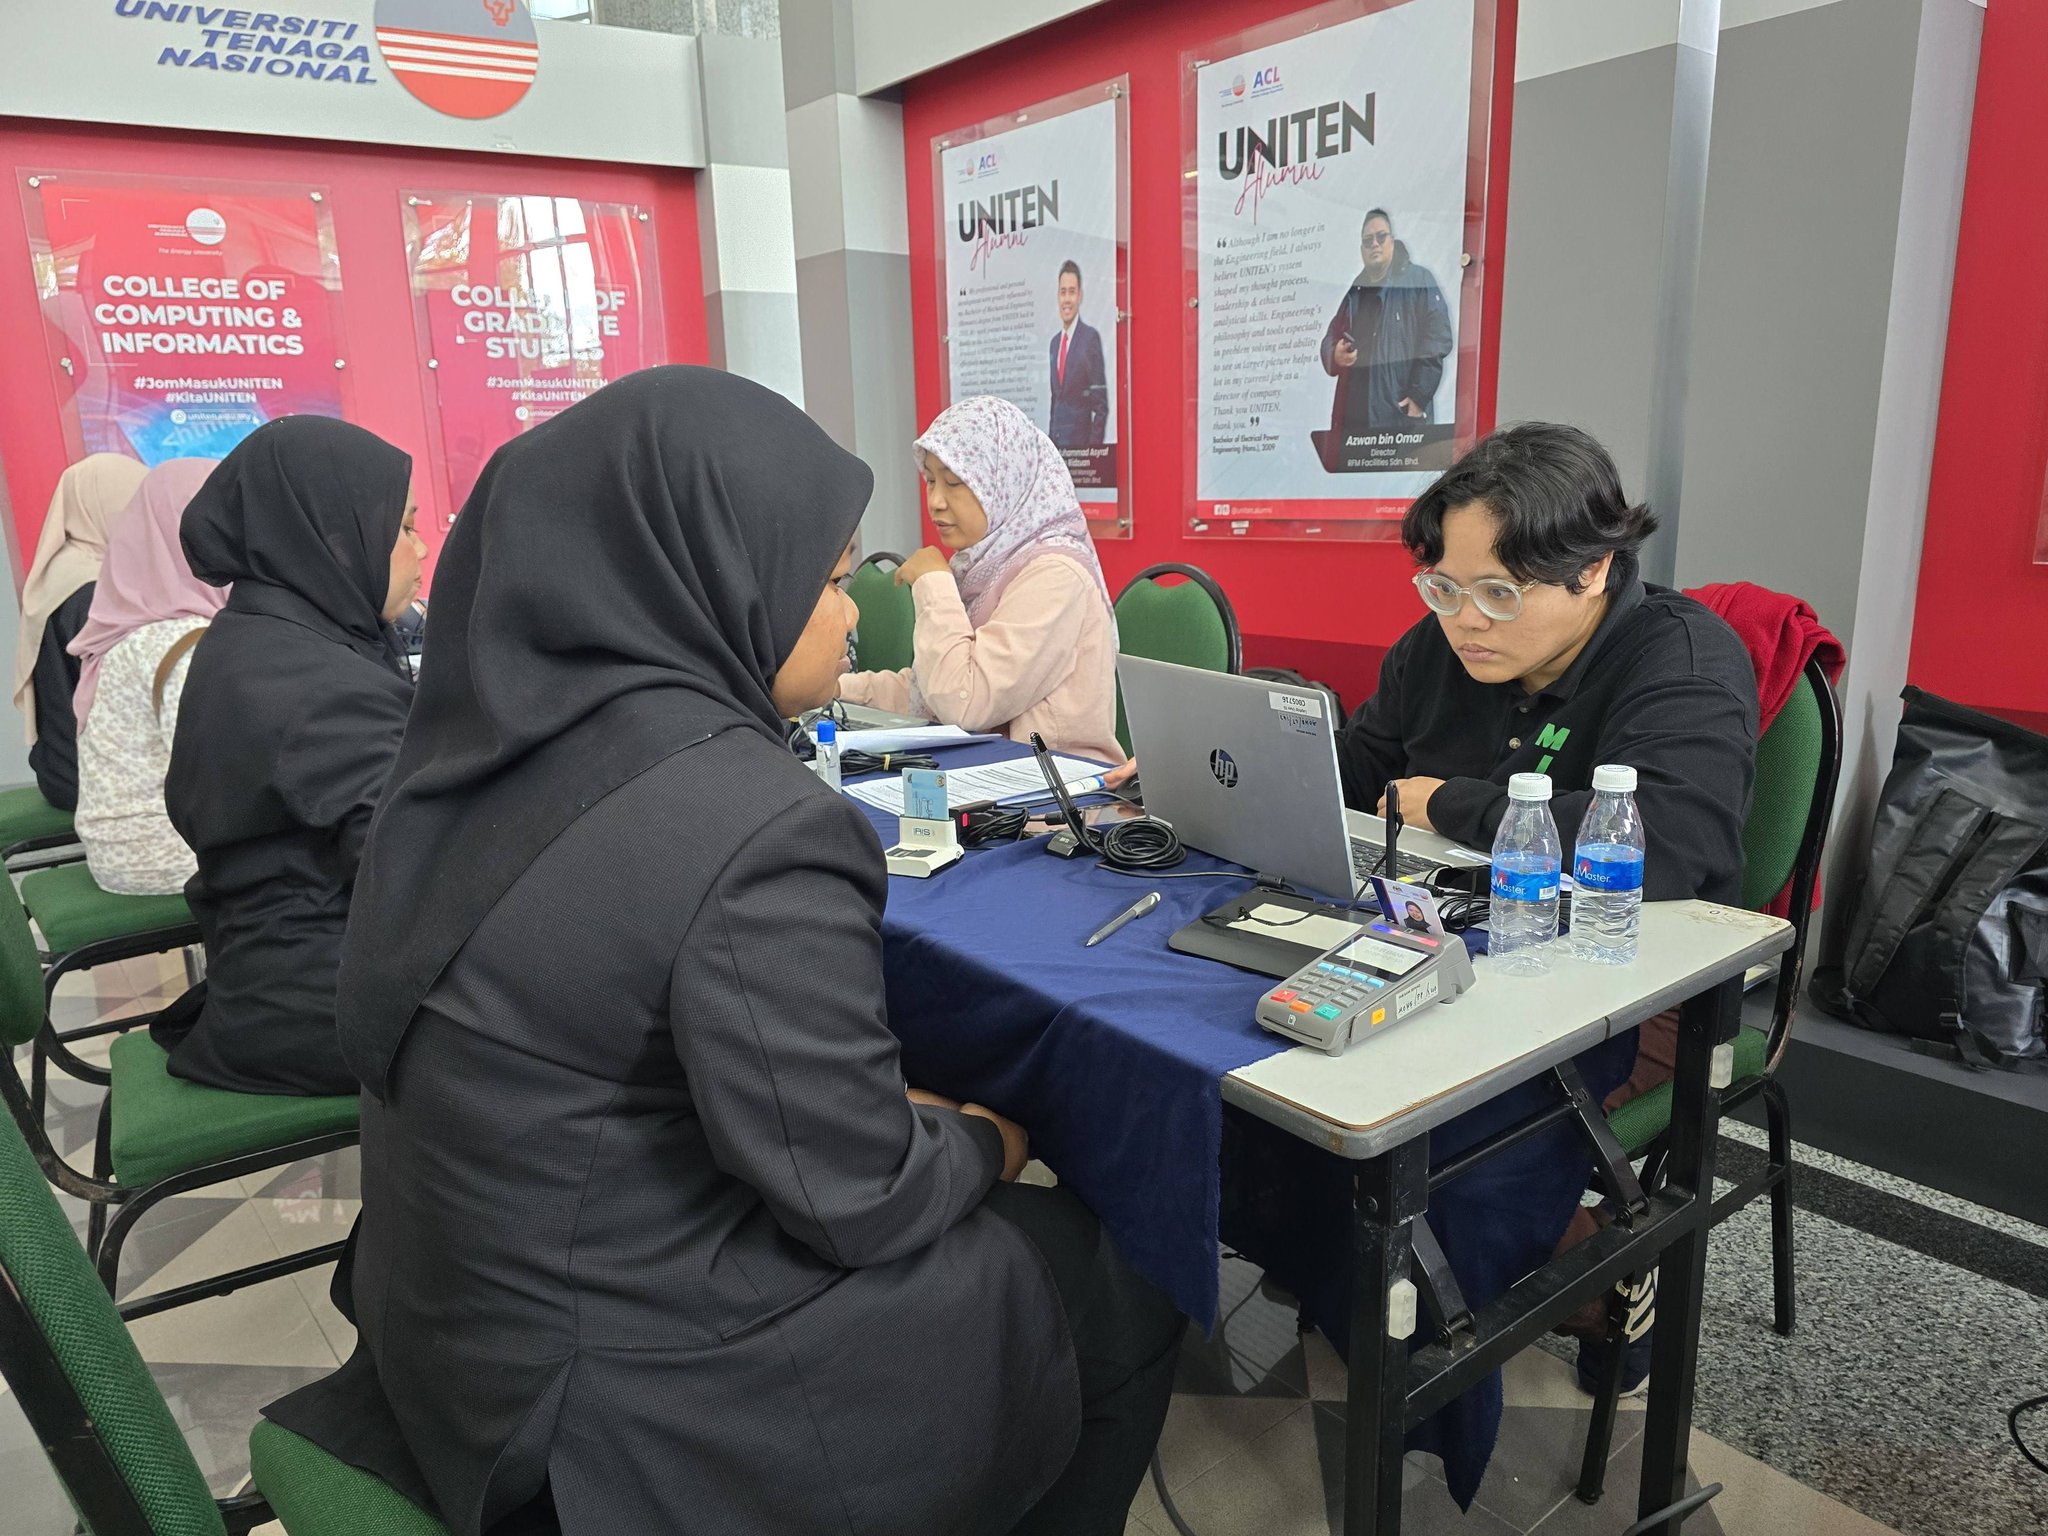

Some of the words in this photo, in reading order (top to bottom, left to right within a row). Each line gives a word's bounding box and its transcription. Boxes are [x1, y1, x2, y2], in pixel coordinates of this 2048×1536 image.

[114, 0, 359, 41] UNIVERSITI
[202, 29, 370, 63] TENAGA
[157, 47, 378, 84] NASIONAL
[1253, 66, 1280, 88] ACL
[1219, 92, 1375, 180] UNITEN
[979, 154, 997, 170] ACL
[1234, 142, 1325, 226] Alumni
[958, 179, 1058, 242] UNITEN
[1228, 233, 1260, 249] Although
[1267, 233, 1278, 241] am
[1280, 231, 1289, 240] no
[1291, 226, 1316, 238] longer
[1317, 223, 1325, 232] in
[1213, 256, 1224, 266] the
[1226, 250, 1269, 266] Engineering
[1295, 241, 1322, 253] always
[1214, 270, 1238, 282] believe
[1278, 261, 1302, 274] system
[103, 275, 240, 299] COLLEGE
[245, 279, 286, 300] OF
[1214, 284, 1238, 298] shaped
[1239, 286, 1250, 296] my
[1250, 278, 1278, 293] thought
[1214, 298, 1249, 313] leadership
[1251, 297, 1257, 307] &
[1258, 294, 1280, 306] ethics
[1282, 291, 1296, 303] and
[95, 304, 275, 328] COMPUTING
[282, 308, 302, 328] &
[1213, 314, 1247, 328] analytical
[1213, 330, 1250, 344] philosophy
[1251, 326, 1265, 338] and
[1266, 325, 1284, 336] tools
[1286, 320, 1322, 336] especially
[102, 332, 304, 355] INFORMATICS
[1222, 345, 1250, 358] problem
[1252, 342, 1277, 354] solving
[1278, 340, 1292, 350] and
[1293, 337, 1316, 349] ability
[1292, 354, 1312, 366] helps
[134, 377, 283, 390] #JomMasukUNITEN
[1244, 374, 1270, 384] current
[1270, 373, 1282, 384] job
[165, 392, 257, 404] #KitaUNITEN
[1213, 392, 1240, 401] director
[1241, 389, 1250, 401] of
[1213, 406, 1234, 416] Thank
[1236, 406, 1248, 416] you
[1213, 420, 1231, 430] thank
[1213, 435, 1234, 444] Bachelor
[1241, 434, 1262, 442] Electrical
[1213, 446, 1242, 455] Engineering
[1262, 443, 1276, 452] 2009
[1346, 436, 1378, 446] Azwan
[1378, 433, 1394, 444] bin
[1396, 432, 1424, 444] Omar
[1361, 458, 1388, 467] Facilities
[1370, 448, 1396, 456] Director
[1535, 722, 1571, 751] M
[1210, 748, 1238, 788] hp
